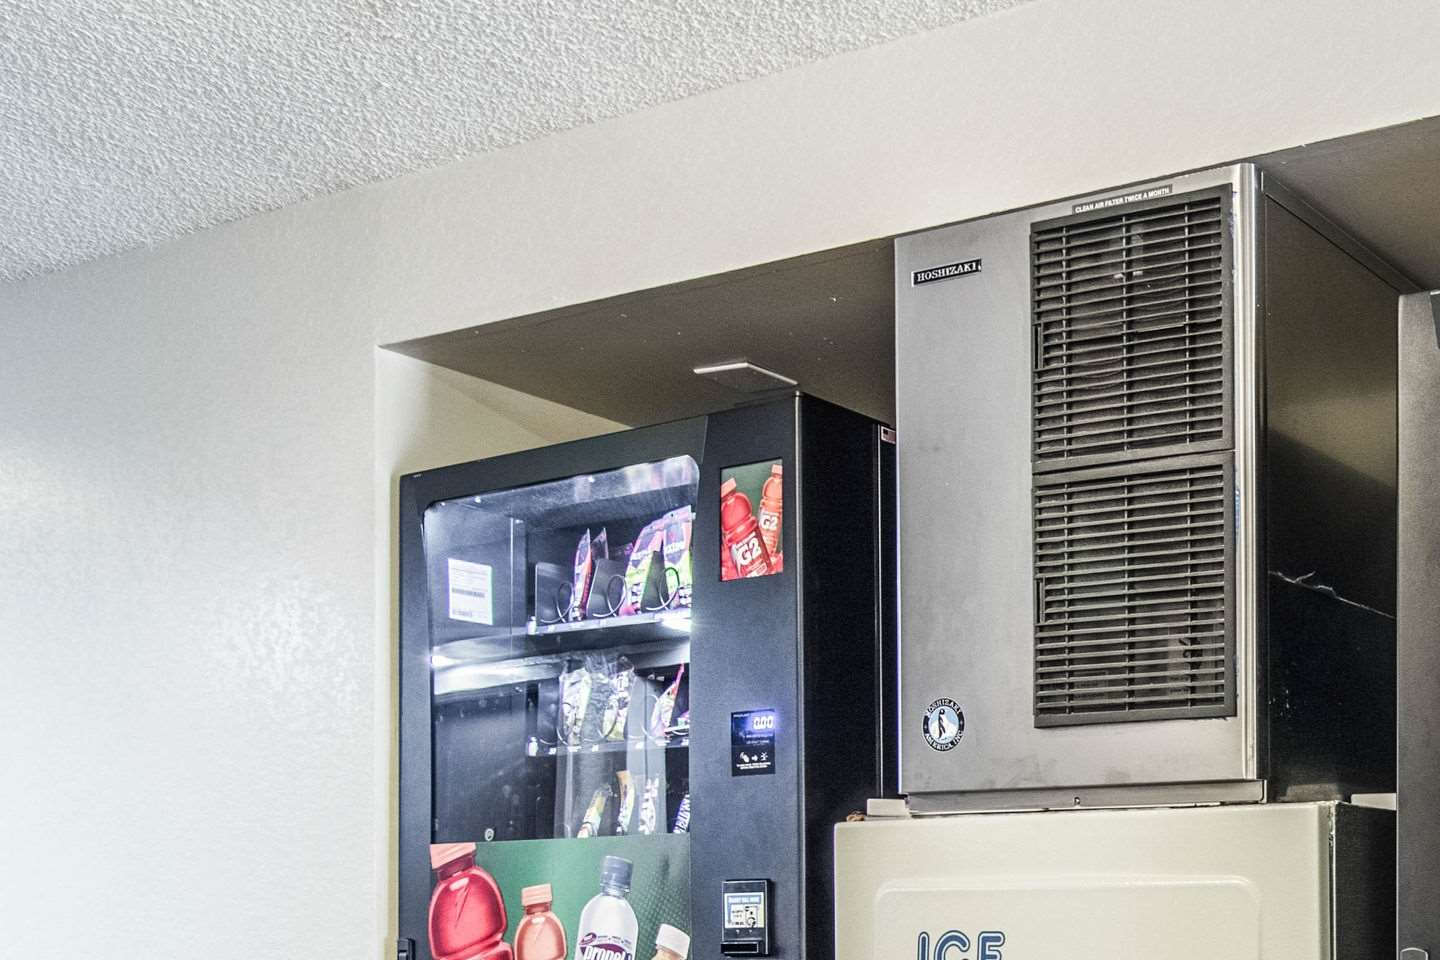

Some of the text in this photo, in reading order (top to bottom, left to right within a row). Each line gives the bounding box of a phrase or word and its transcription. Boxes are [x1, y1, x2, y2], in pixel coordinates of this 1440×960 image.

[1075, 203, 1094, 213] CLEAN
[1094, 201, 1104, 209] AIR
[1105, 198, 1123, 207] FILTER
[1124, 193, 1142, 203] TWICE
[1148, 187, 1169, 198] MONTH
[917, 261, 977, 282] HOSHIZAKI
[760, 512, 779, 531] G2
[738, 537, 763, 566] G2
